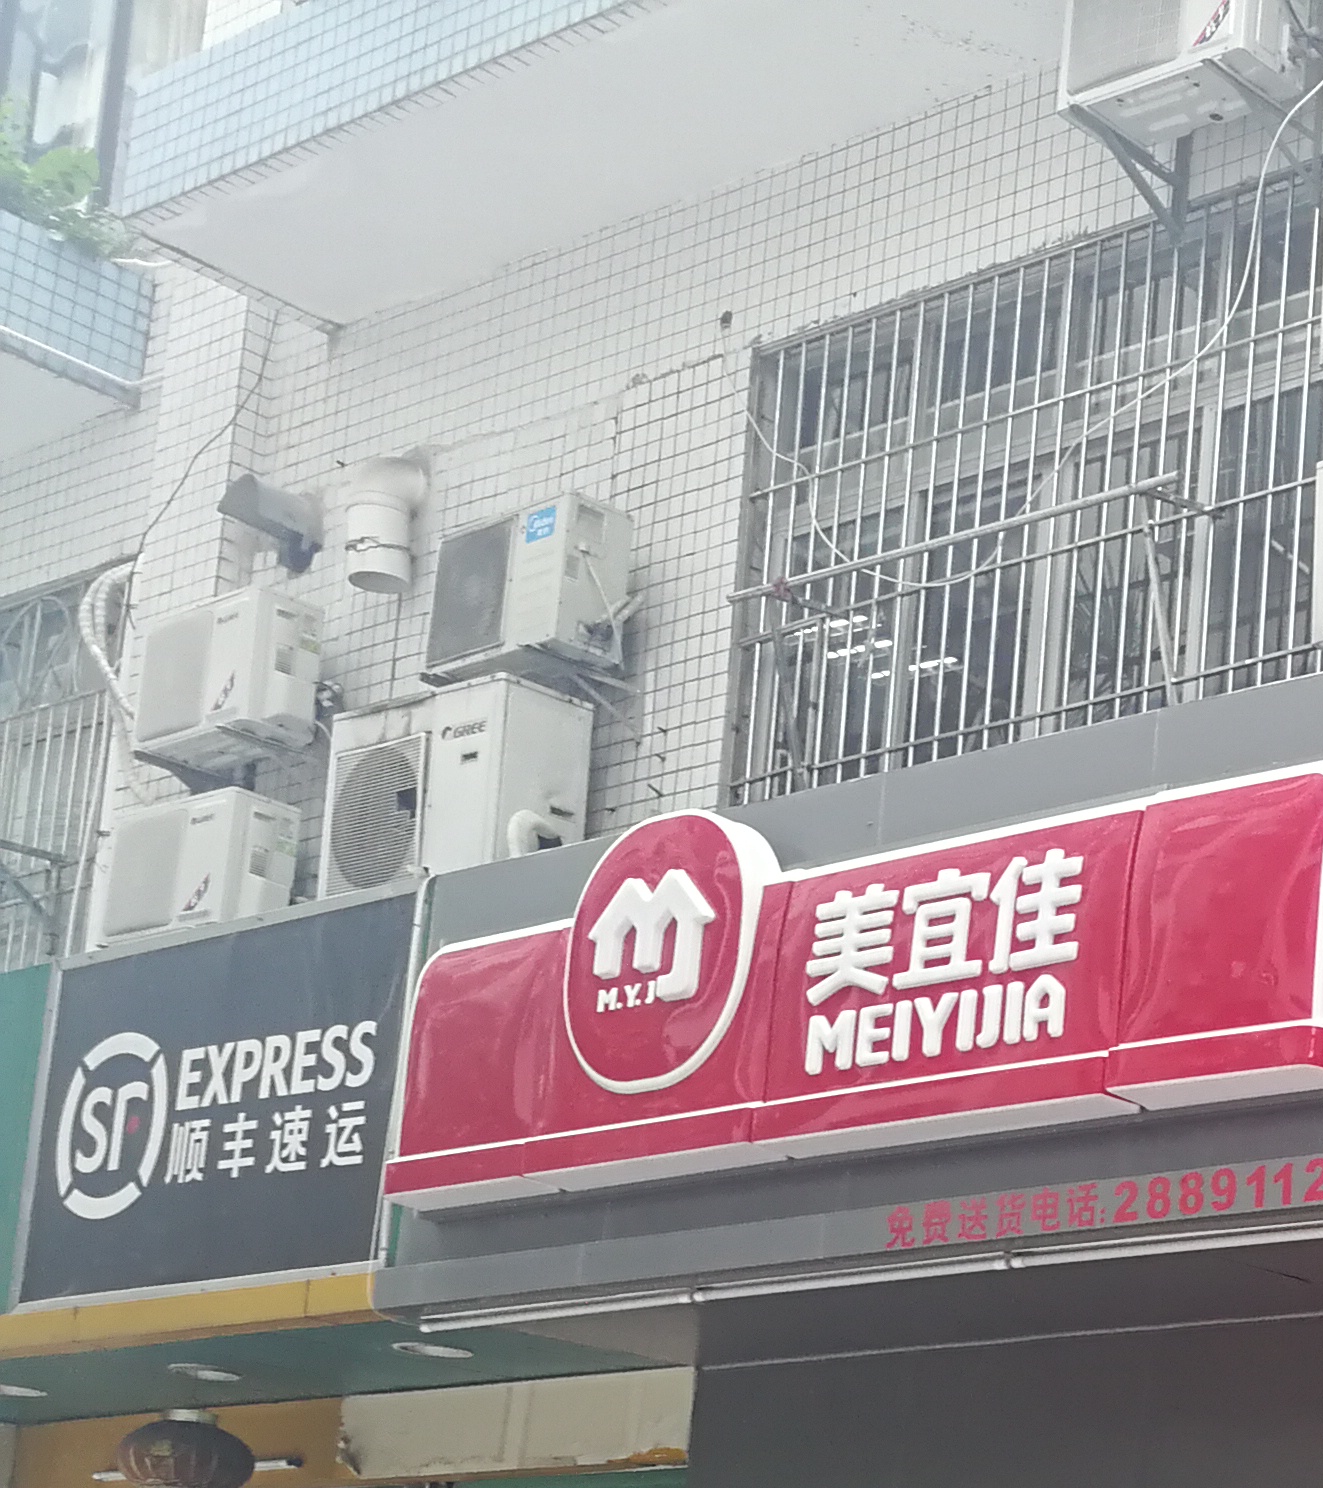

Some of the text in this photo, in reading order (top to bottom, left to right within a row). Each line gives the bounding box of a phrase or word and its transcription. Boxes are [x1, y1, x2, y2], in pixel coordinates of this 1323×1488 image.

[453, 720, 487, 739] GREE
[805, 847, 1084, 1007] 美宜佳
[174, 1020, 379, 1112] EXPRESS
[804, 973, 1067, 1077] MEIYIJIA
[163, 1100, 369, 1184] 顺丰速运
